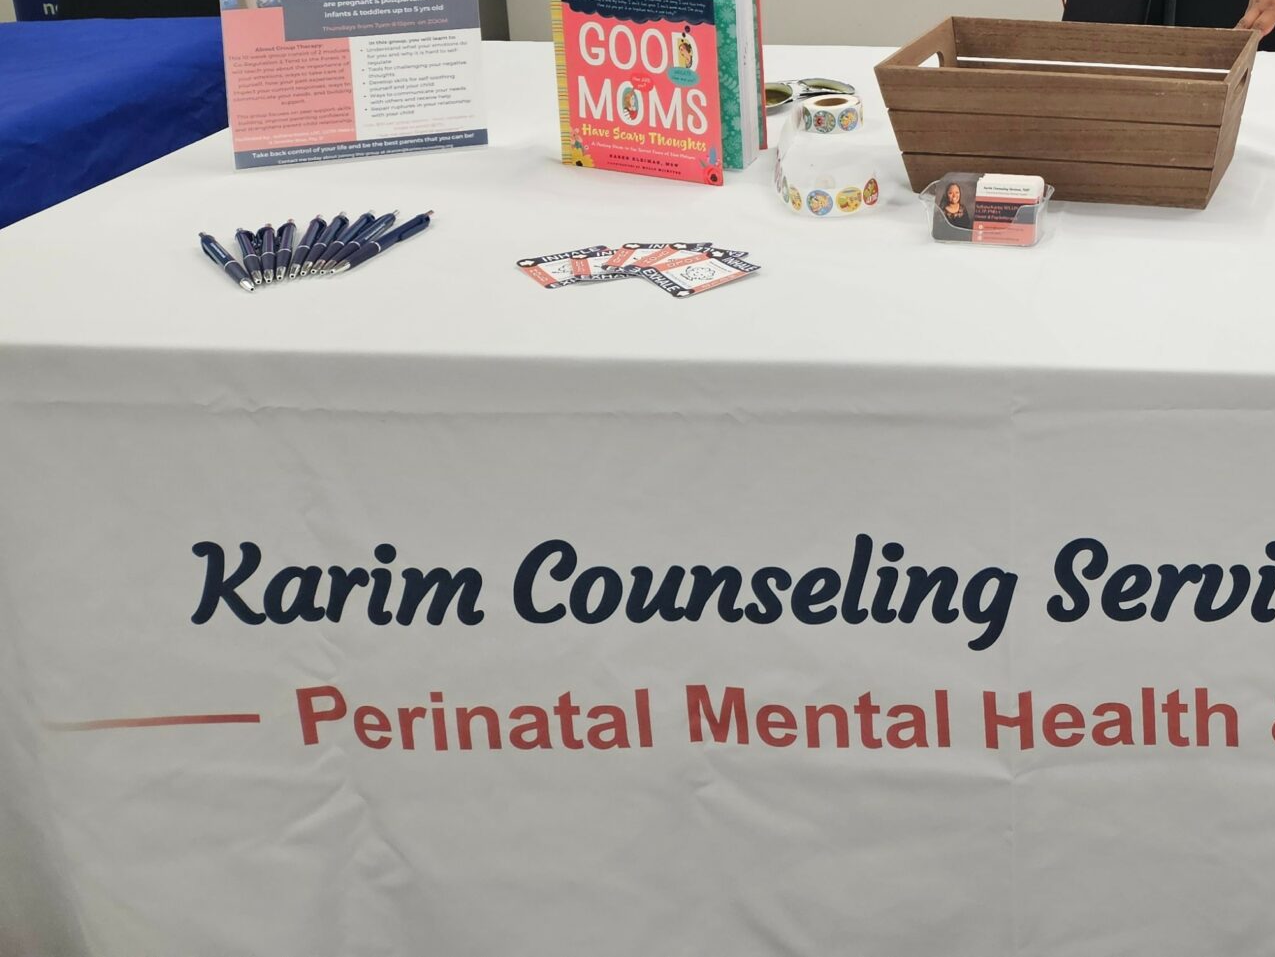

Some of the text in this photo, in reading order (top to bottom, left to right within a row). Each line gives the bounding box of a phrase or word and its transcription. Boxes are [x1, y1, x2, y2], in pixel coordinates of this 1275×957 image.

[324, 10, 351, 18] infants
[359, 8, 390, 16] toddlers
[579, 21, 699, 74] GOOD
[577, 76, 708, 135] MOMS
[252, 151, 269, 159] Take
[287, 147, 312, 156] control
[581, 123, 610, 138] Have
[613, 127, 645, 144] Scary
[648, 132, 707, 153] Thoughts
[643, 268, 680, 292] EXHALE
[191, 540, 486, 627] Karim
[511, 533, 1019, 652] Counseling
[295, 685, 653, 751] Perinatal
[685, 683, 951, 749] Mental
[983, 687, 1240, 751] Health
